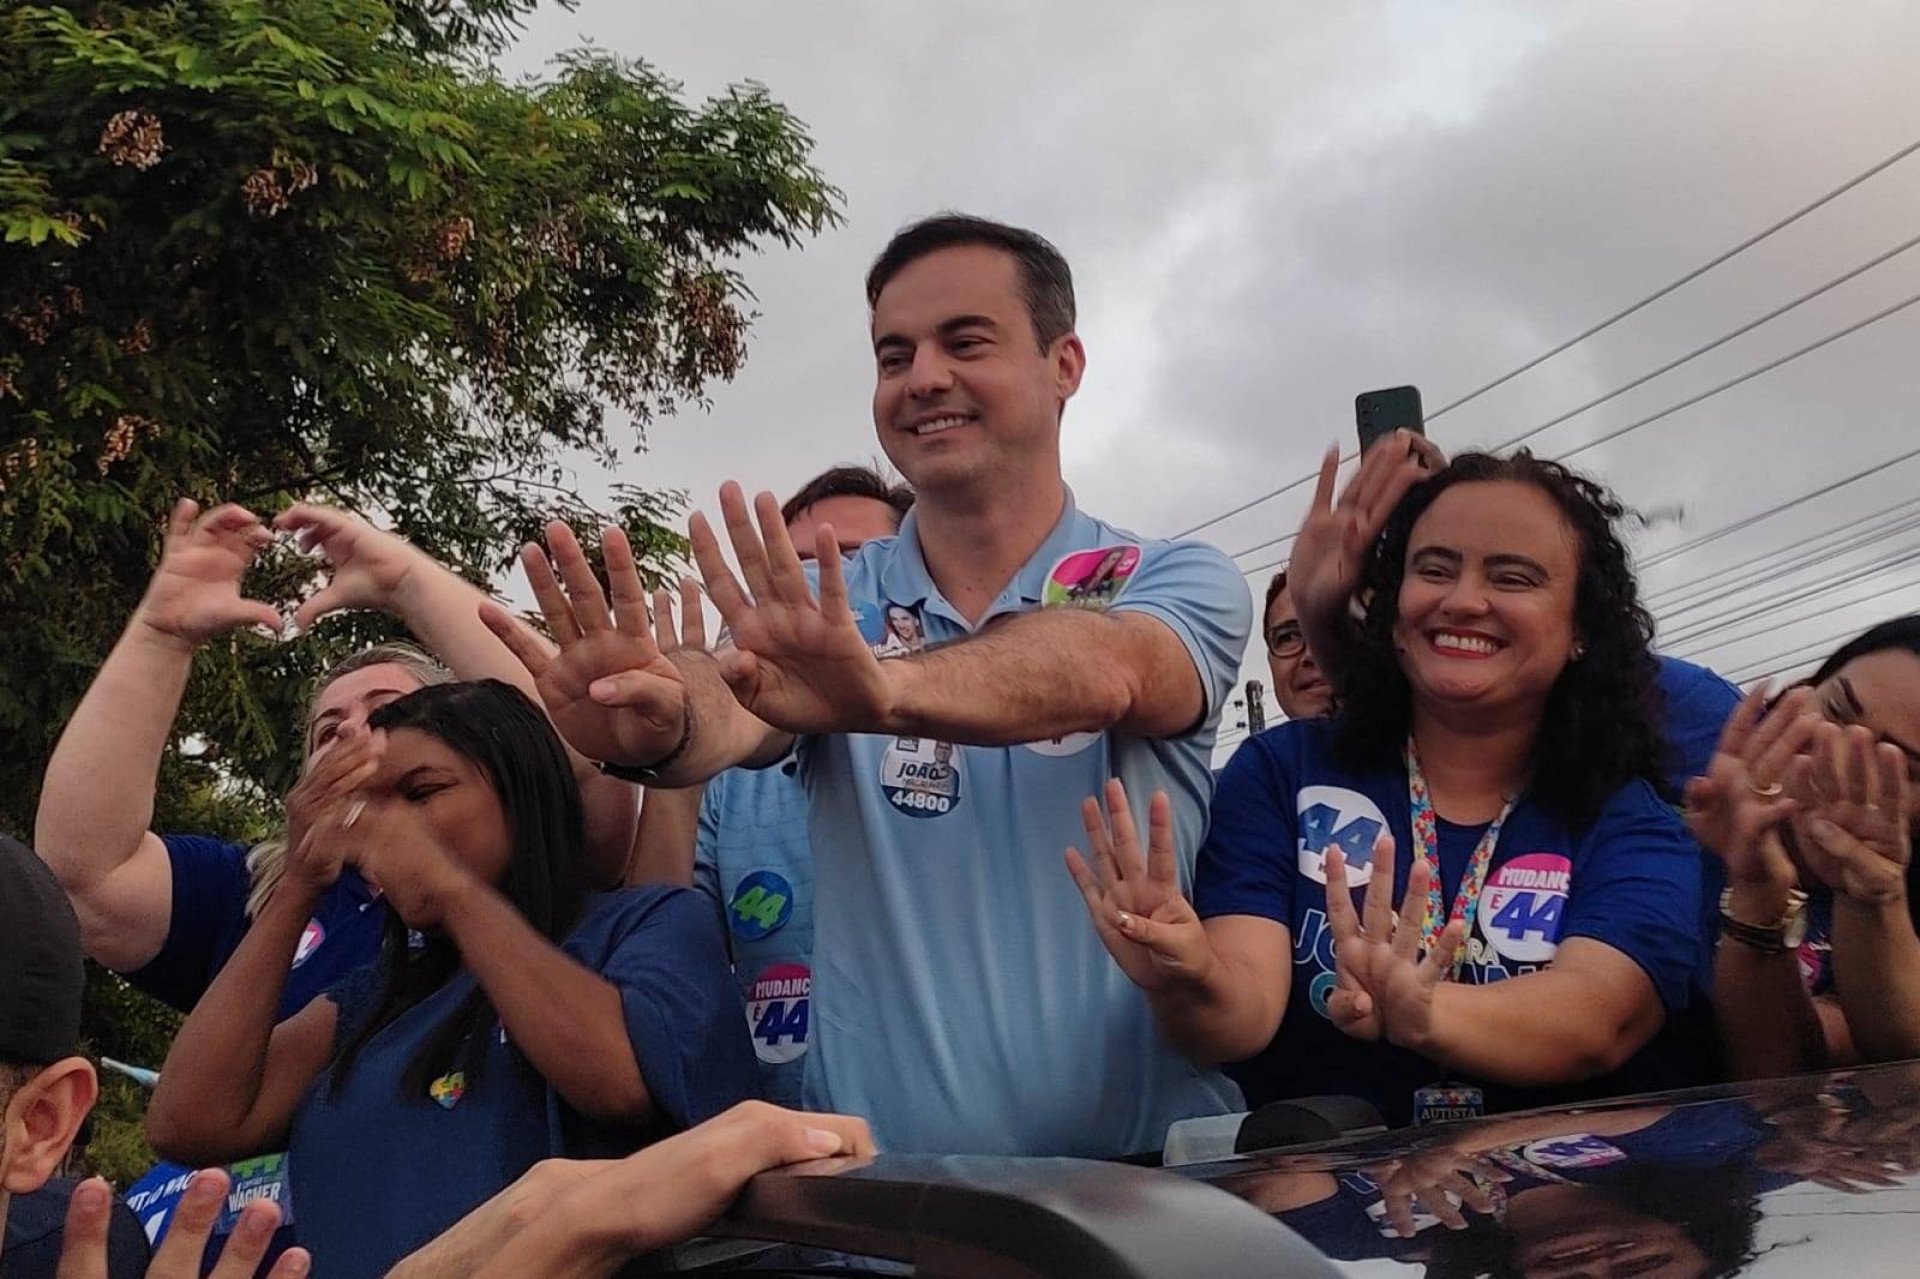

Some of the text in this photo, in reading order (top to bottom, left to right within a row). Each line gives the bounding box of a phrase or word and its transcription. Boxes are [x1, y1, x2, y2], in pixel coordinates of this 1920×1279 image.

[892, 789, 950, 813] 44800
[1298, 802, 1383, 871] 44
[731, 885, 787, 929] 44
[1490, 891, 1565, 943] 44
[754, 999, 810, 1046] 44
[1421, 1106, 1477, 1120] AUTISTA
[228, 1182, 282, 1213] WAGNER
